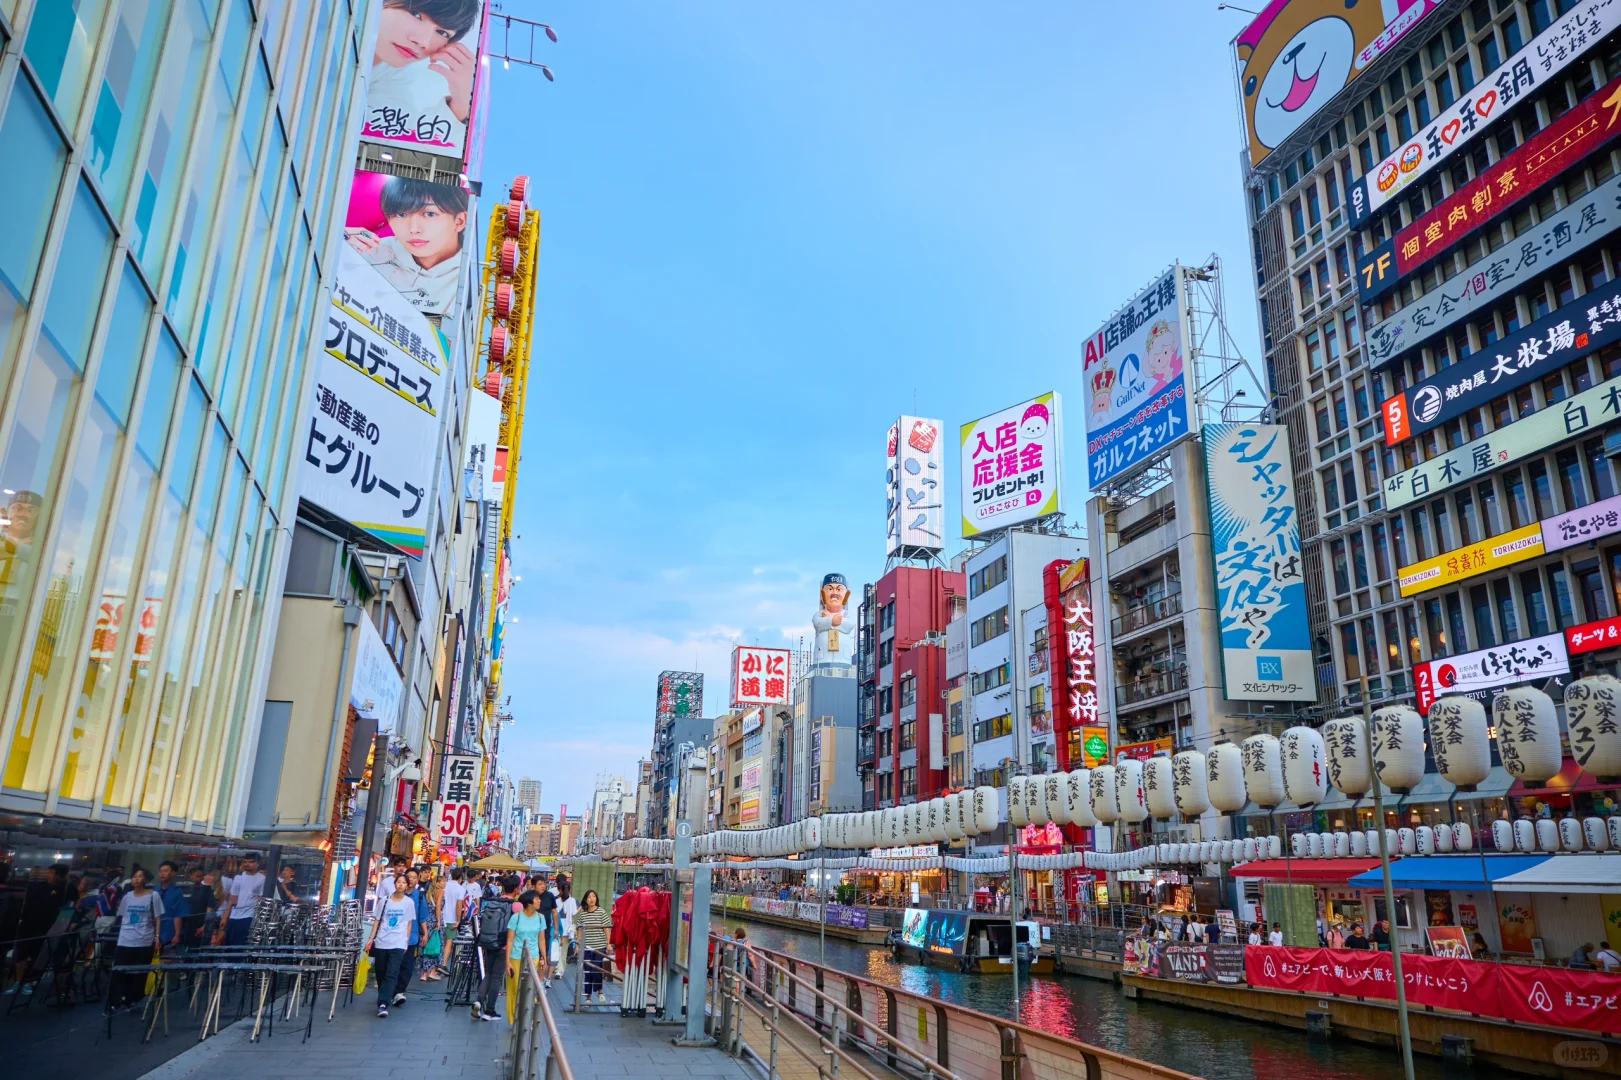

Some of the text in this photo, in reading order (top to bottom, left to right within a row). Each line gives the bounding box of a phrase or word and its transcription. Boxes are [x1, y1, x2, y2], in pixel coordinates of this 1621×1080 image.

[1361, 9, 1418, 62] モモエだよ!
[1541, 20, 1602, 72] すき焼き
[361, 106, 451, 143] 激的
[1525, 119, 1599, 171] KATANA
[1352, 187, 1363, 219] 8F
[1402, 167, 1520, 260] 個室肉割烹
[1362, 252, 1391, 289] 7F
[1412, 203, 1606, 333] 完全個室居酒屋
[334, 278, 437, 368] ャー・介護事業まで
[1491, 320, 1576, 384] 大牧場
[1445, 370, 1487, 401] 焼肉屋
[1389, 402, 1402, 438] 5F
[972, 421, 1017, 459] 入店
[1093, 409, 1181, 481] ガルフネット
[973, 442, 1043, 488] 応援金
[1411, 442, 1495, 497] 白木屋
[973, 470, 1044, 504] プレゼント中!
[1388, 475, 1404, 492] 4F
[1562, 511, 1619, 540] たこやき
[1493, 536, 1537, 556] TORIKIZOKU
[1400, 569, 1436, 586] TORIKIZOKU
[1571, 628, 1604, 646] ダーツ
[742, 653, 785, 676] かに
[1062, 600, 1097, 722] 大阪王将
[1260, 662, 1279, 674] BX
[1419, 672, 1431, 708] 2F
[1385, 713, 1403, 750] 心栄会
[1443, 704, 1464, 745] 心栄会
[1513, 698, 1538, 742] 心栄会
[1251, 739, 1266, 772] 心栄会
[1288, 733, 1299, 760] 心栄会
[1339, 722, 1356, 758] 心栄会
[447, 758, 475, 803] 伝串
[1146, 762, 1157, 790] 心栄会
[1179, 756, 1192, 786] 心栄会
[1208, 750, 1219, 782] 心栄会
[440, 803, 471, 836] 50
[1281, 962, 1468, 993] #エアビーで、新しい大阪をつけにいこう
